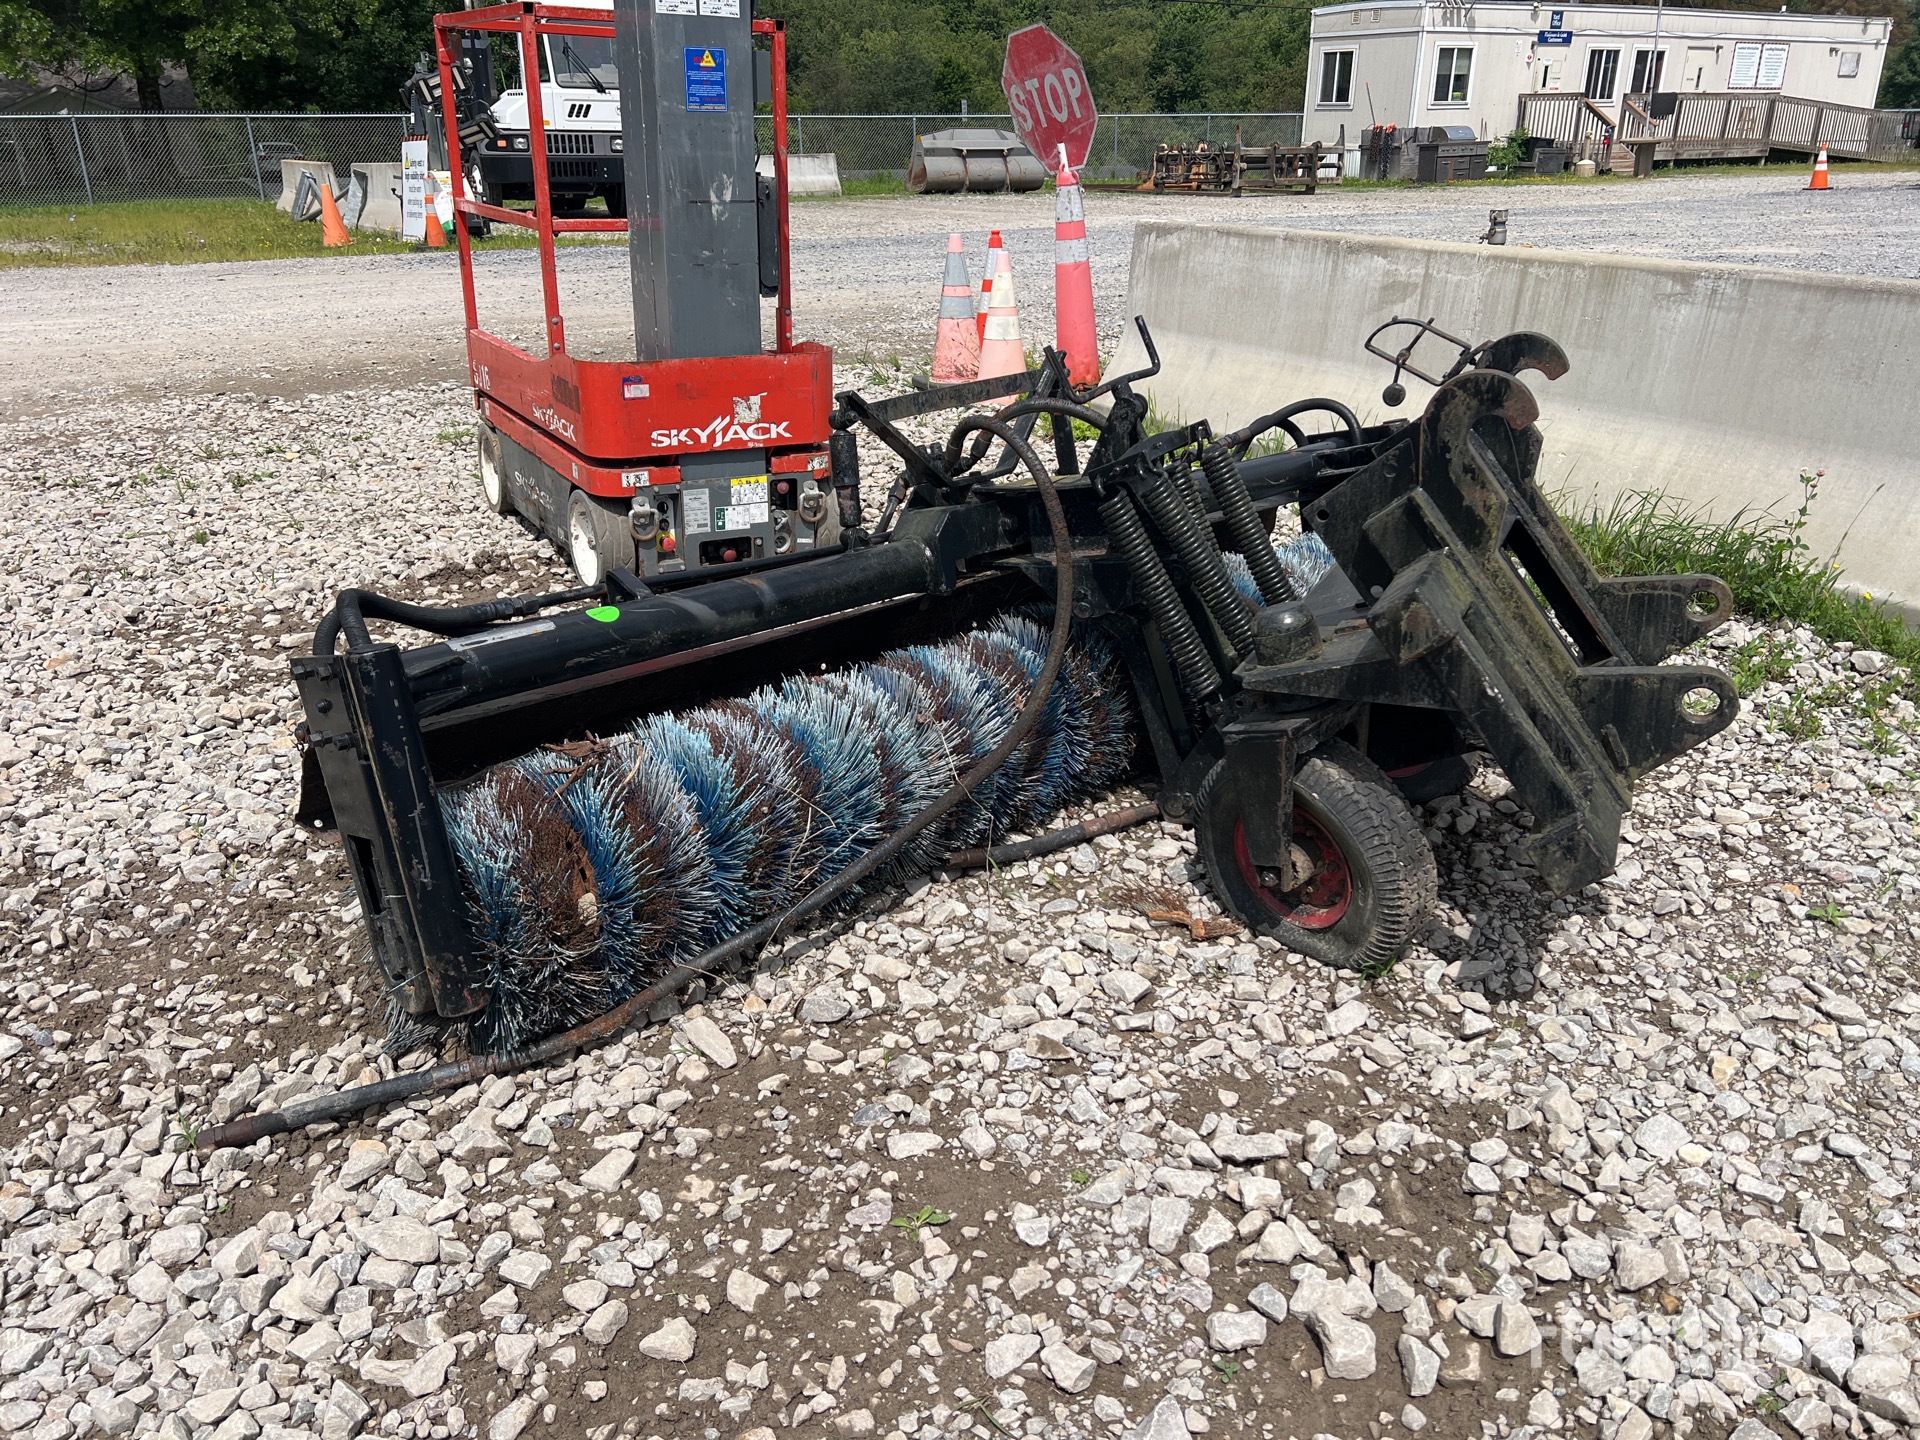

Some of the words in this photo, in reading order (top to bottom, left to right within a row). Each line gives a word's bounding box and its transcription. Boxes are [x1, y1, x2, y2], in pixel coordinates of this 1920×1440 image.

[1009, 67, 1082, 132] STOP
[532, 403, 577, 442] SKYJACK
[650, 415, 793, 448] SKYJACK
[514, 471, 555, 513] SKYACK
